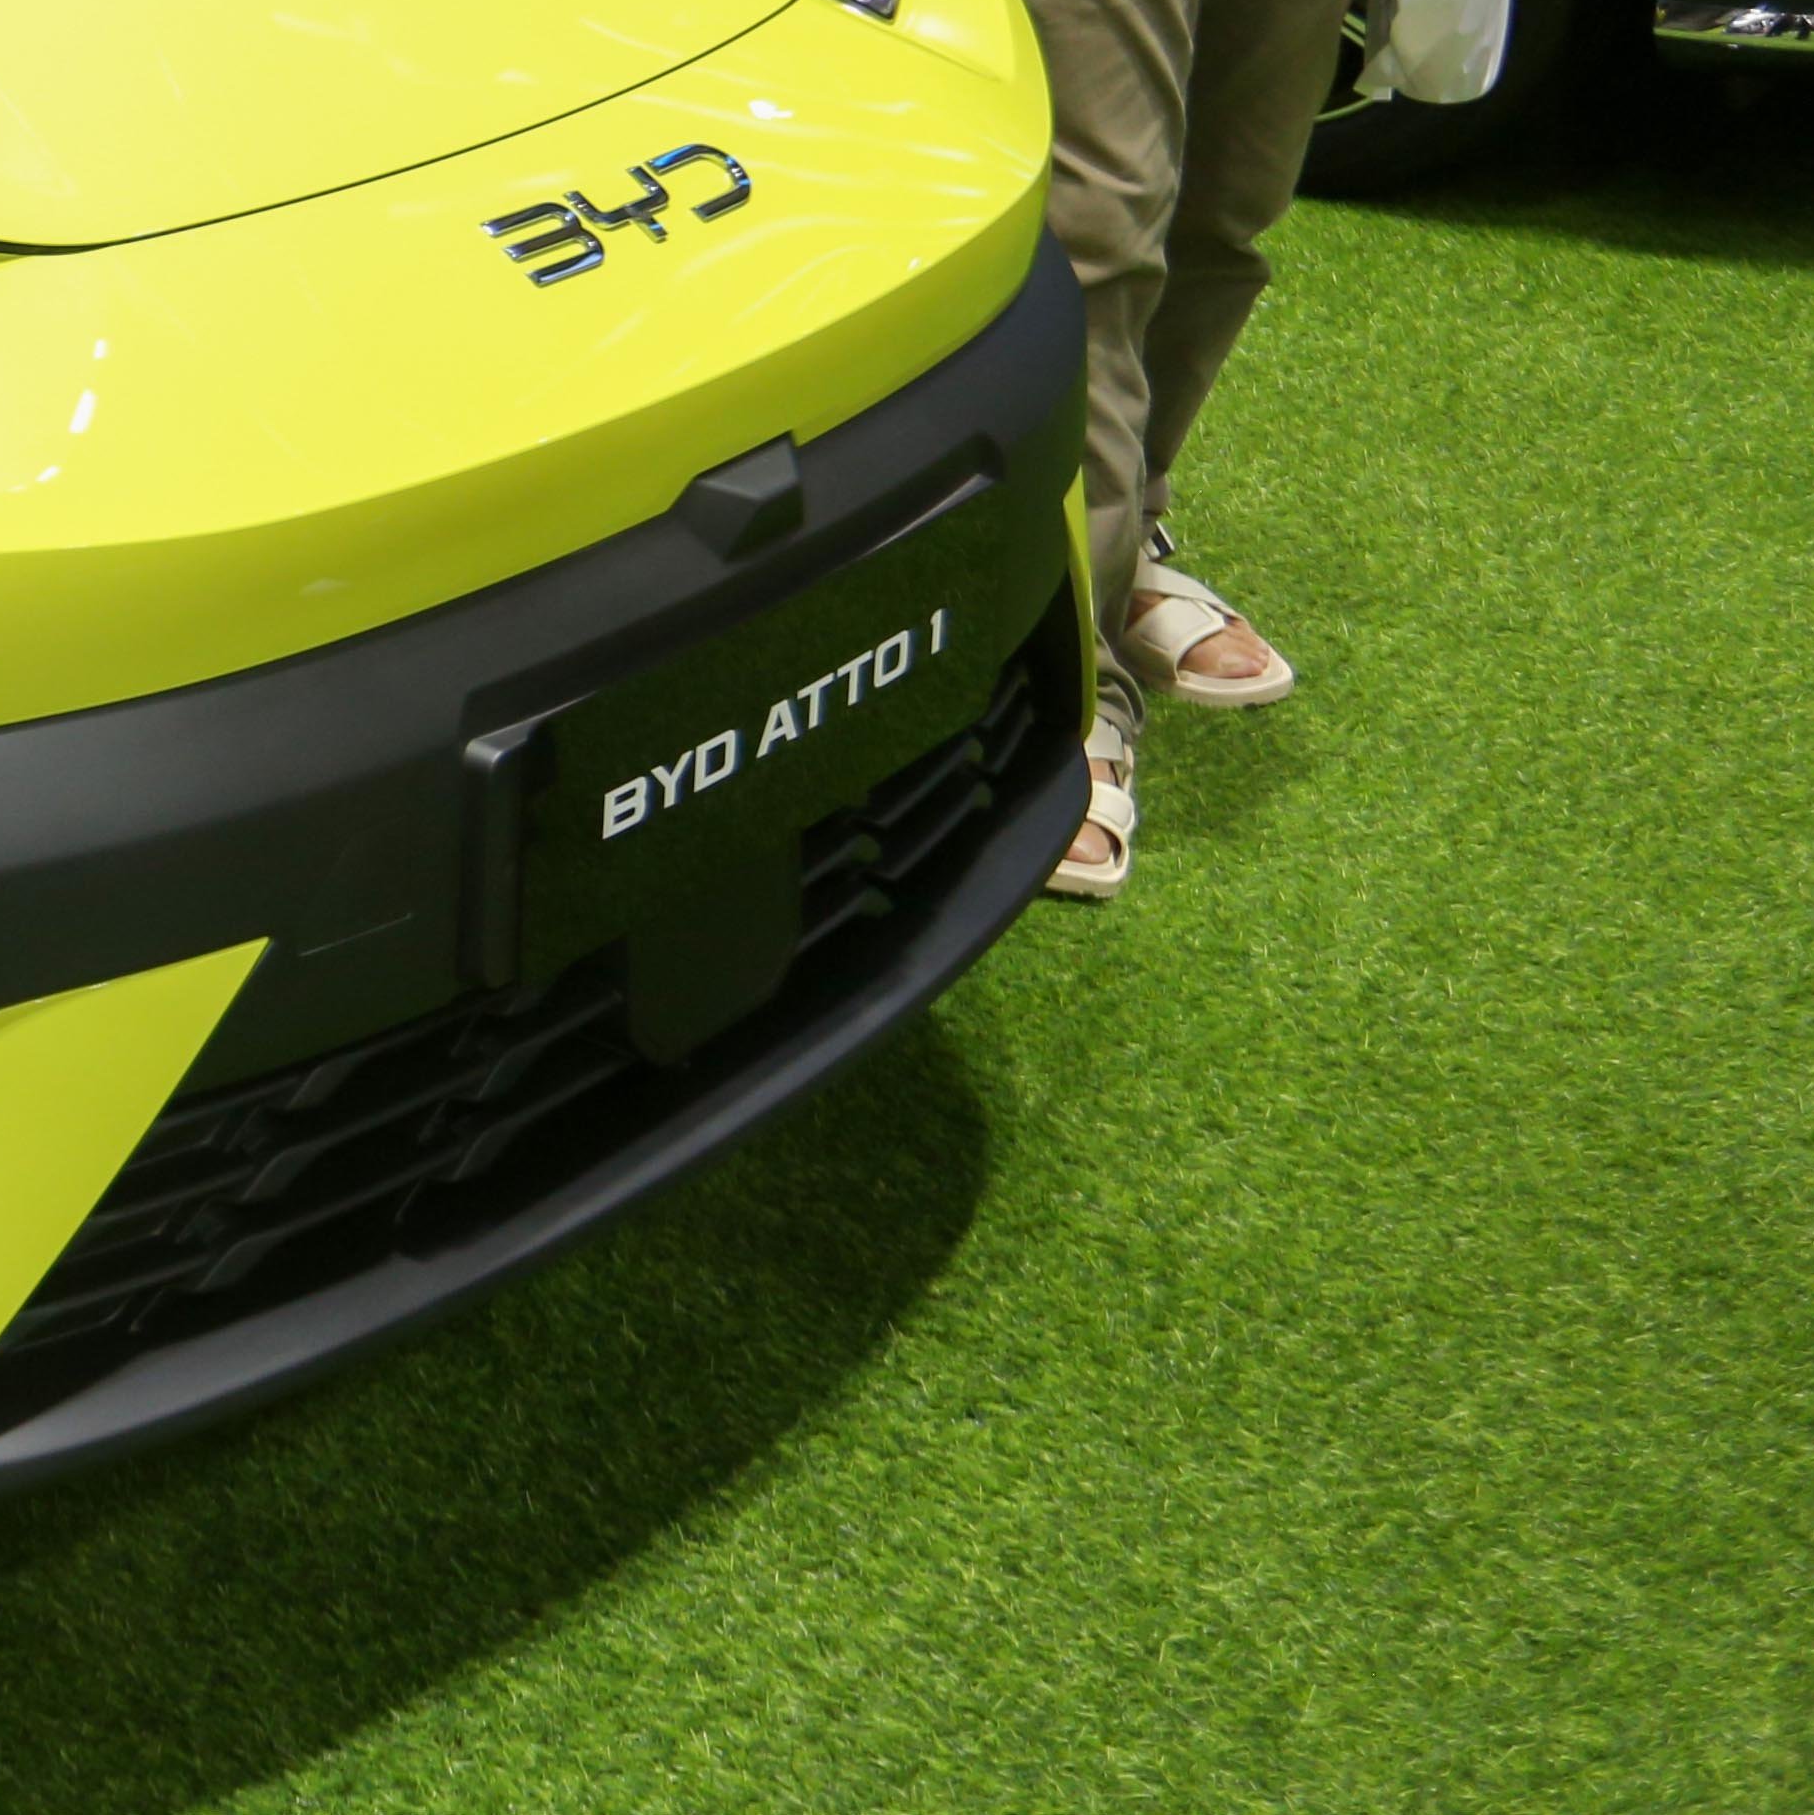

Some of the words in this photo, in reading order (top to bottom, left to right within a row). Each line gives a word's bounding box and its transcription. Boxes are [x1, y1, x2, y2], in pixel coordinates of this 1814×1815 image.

[480, 143, 752, 288] BYD
[602, 729, 740, 840] BYD
[756, 629, 914, 757] ATTO
[929, 608, 950, 655] 1
